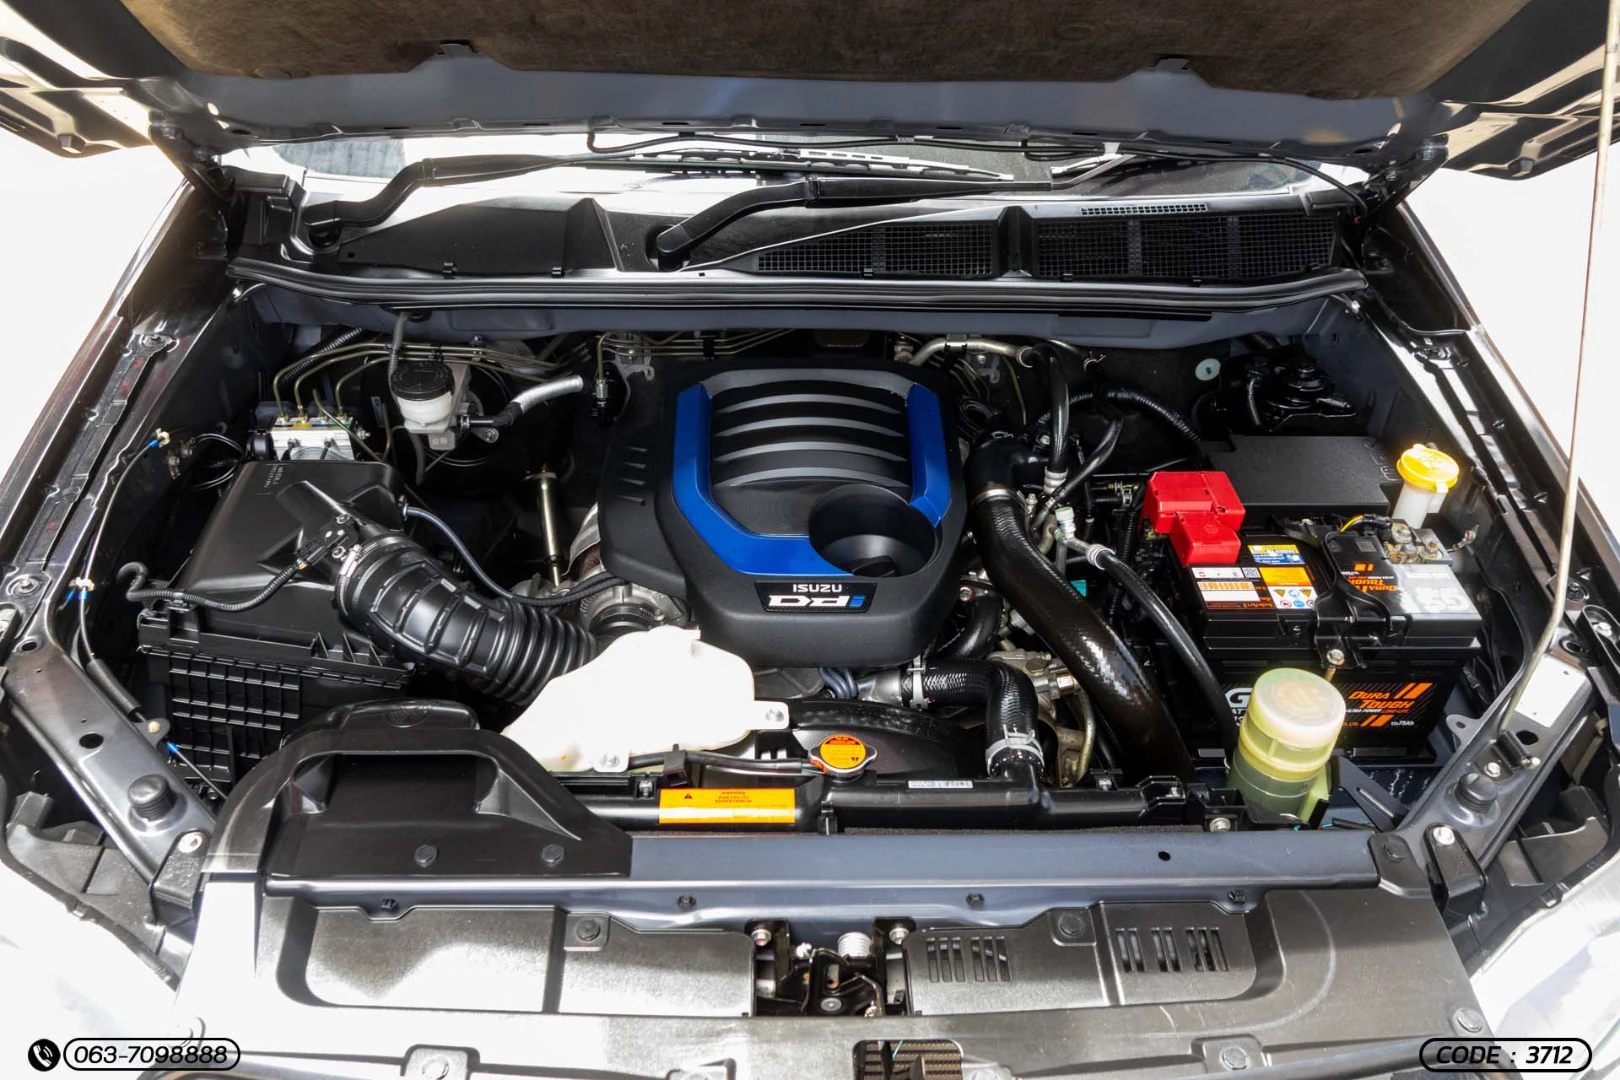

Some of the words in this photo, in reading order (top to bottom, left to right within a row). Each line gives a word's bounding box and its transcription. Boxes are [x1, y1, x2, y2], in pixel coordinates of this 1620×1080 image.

[792, 584, 843, 593] ISUZU
[1348, 691, 1390, 699] DURA
[1359, 700, 1415, 708] TOUGH
